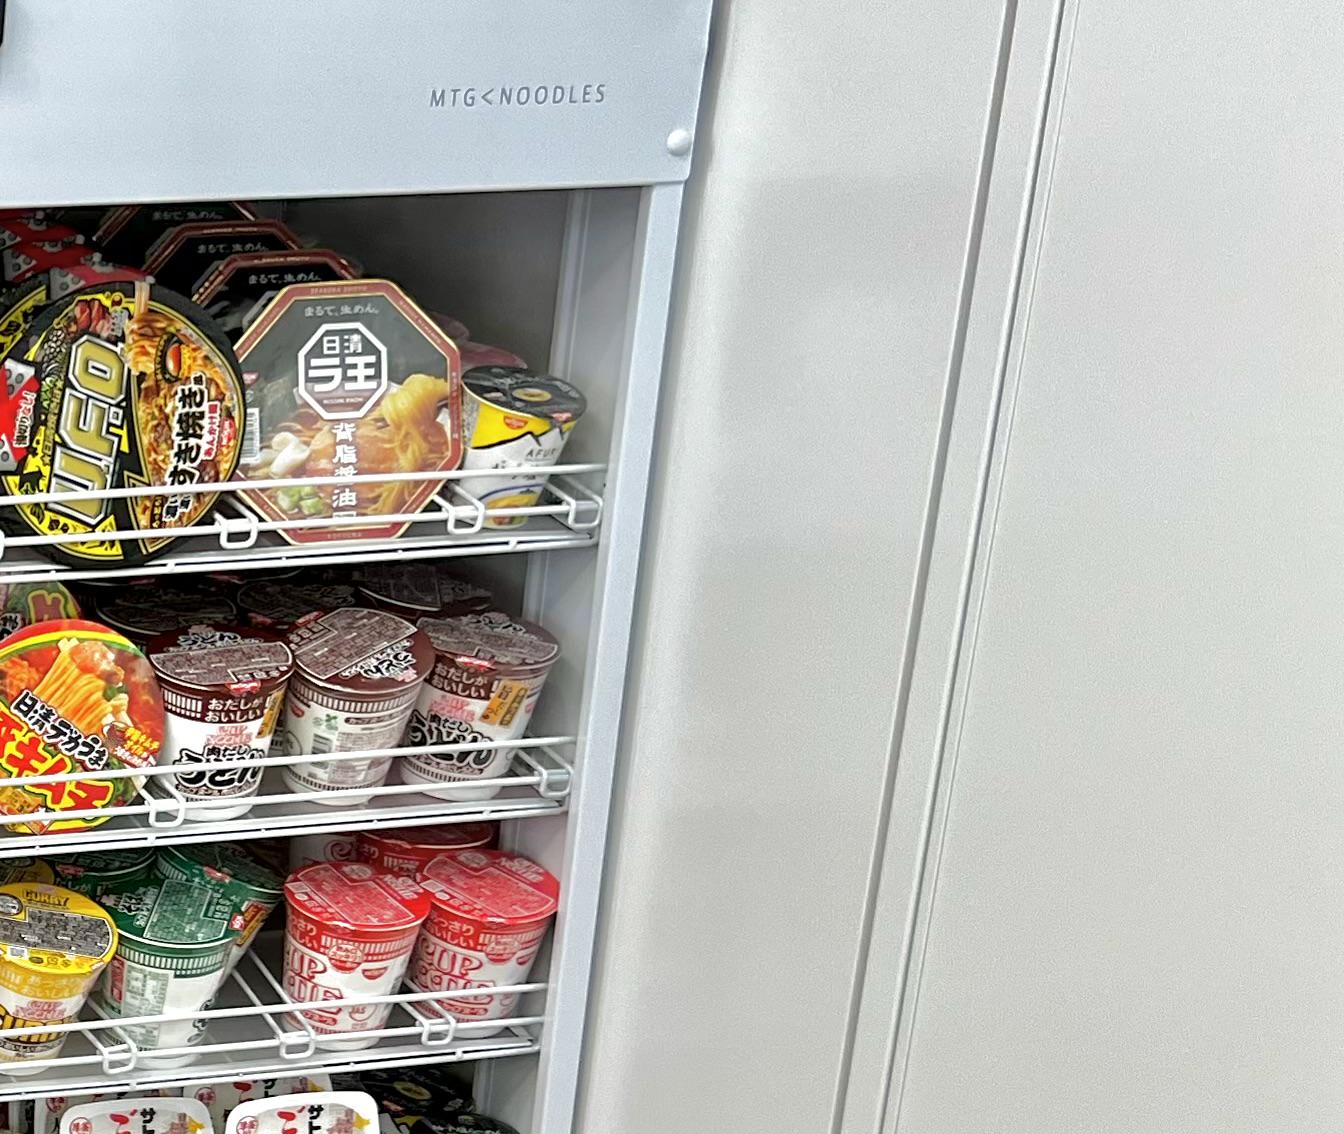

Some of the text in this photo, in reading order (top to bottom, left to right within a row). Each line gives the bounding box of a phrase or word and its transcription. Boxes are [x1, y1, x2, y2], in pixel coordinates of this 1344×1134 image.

[322, 334, 362, 355] 日清
[307, 355, 379, 392] ラ王
[430, 674, 487, 700] おいしい
[434, 661, 489, 687] おだしが
[12, 690, 109, 771] 日清デカうま
[21, 890, 70, 907] CURRY
